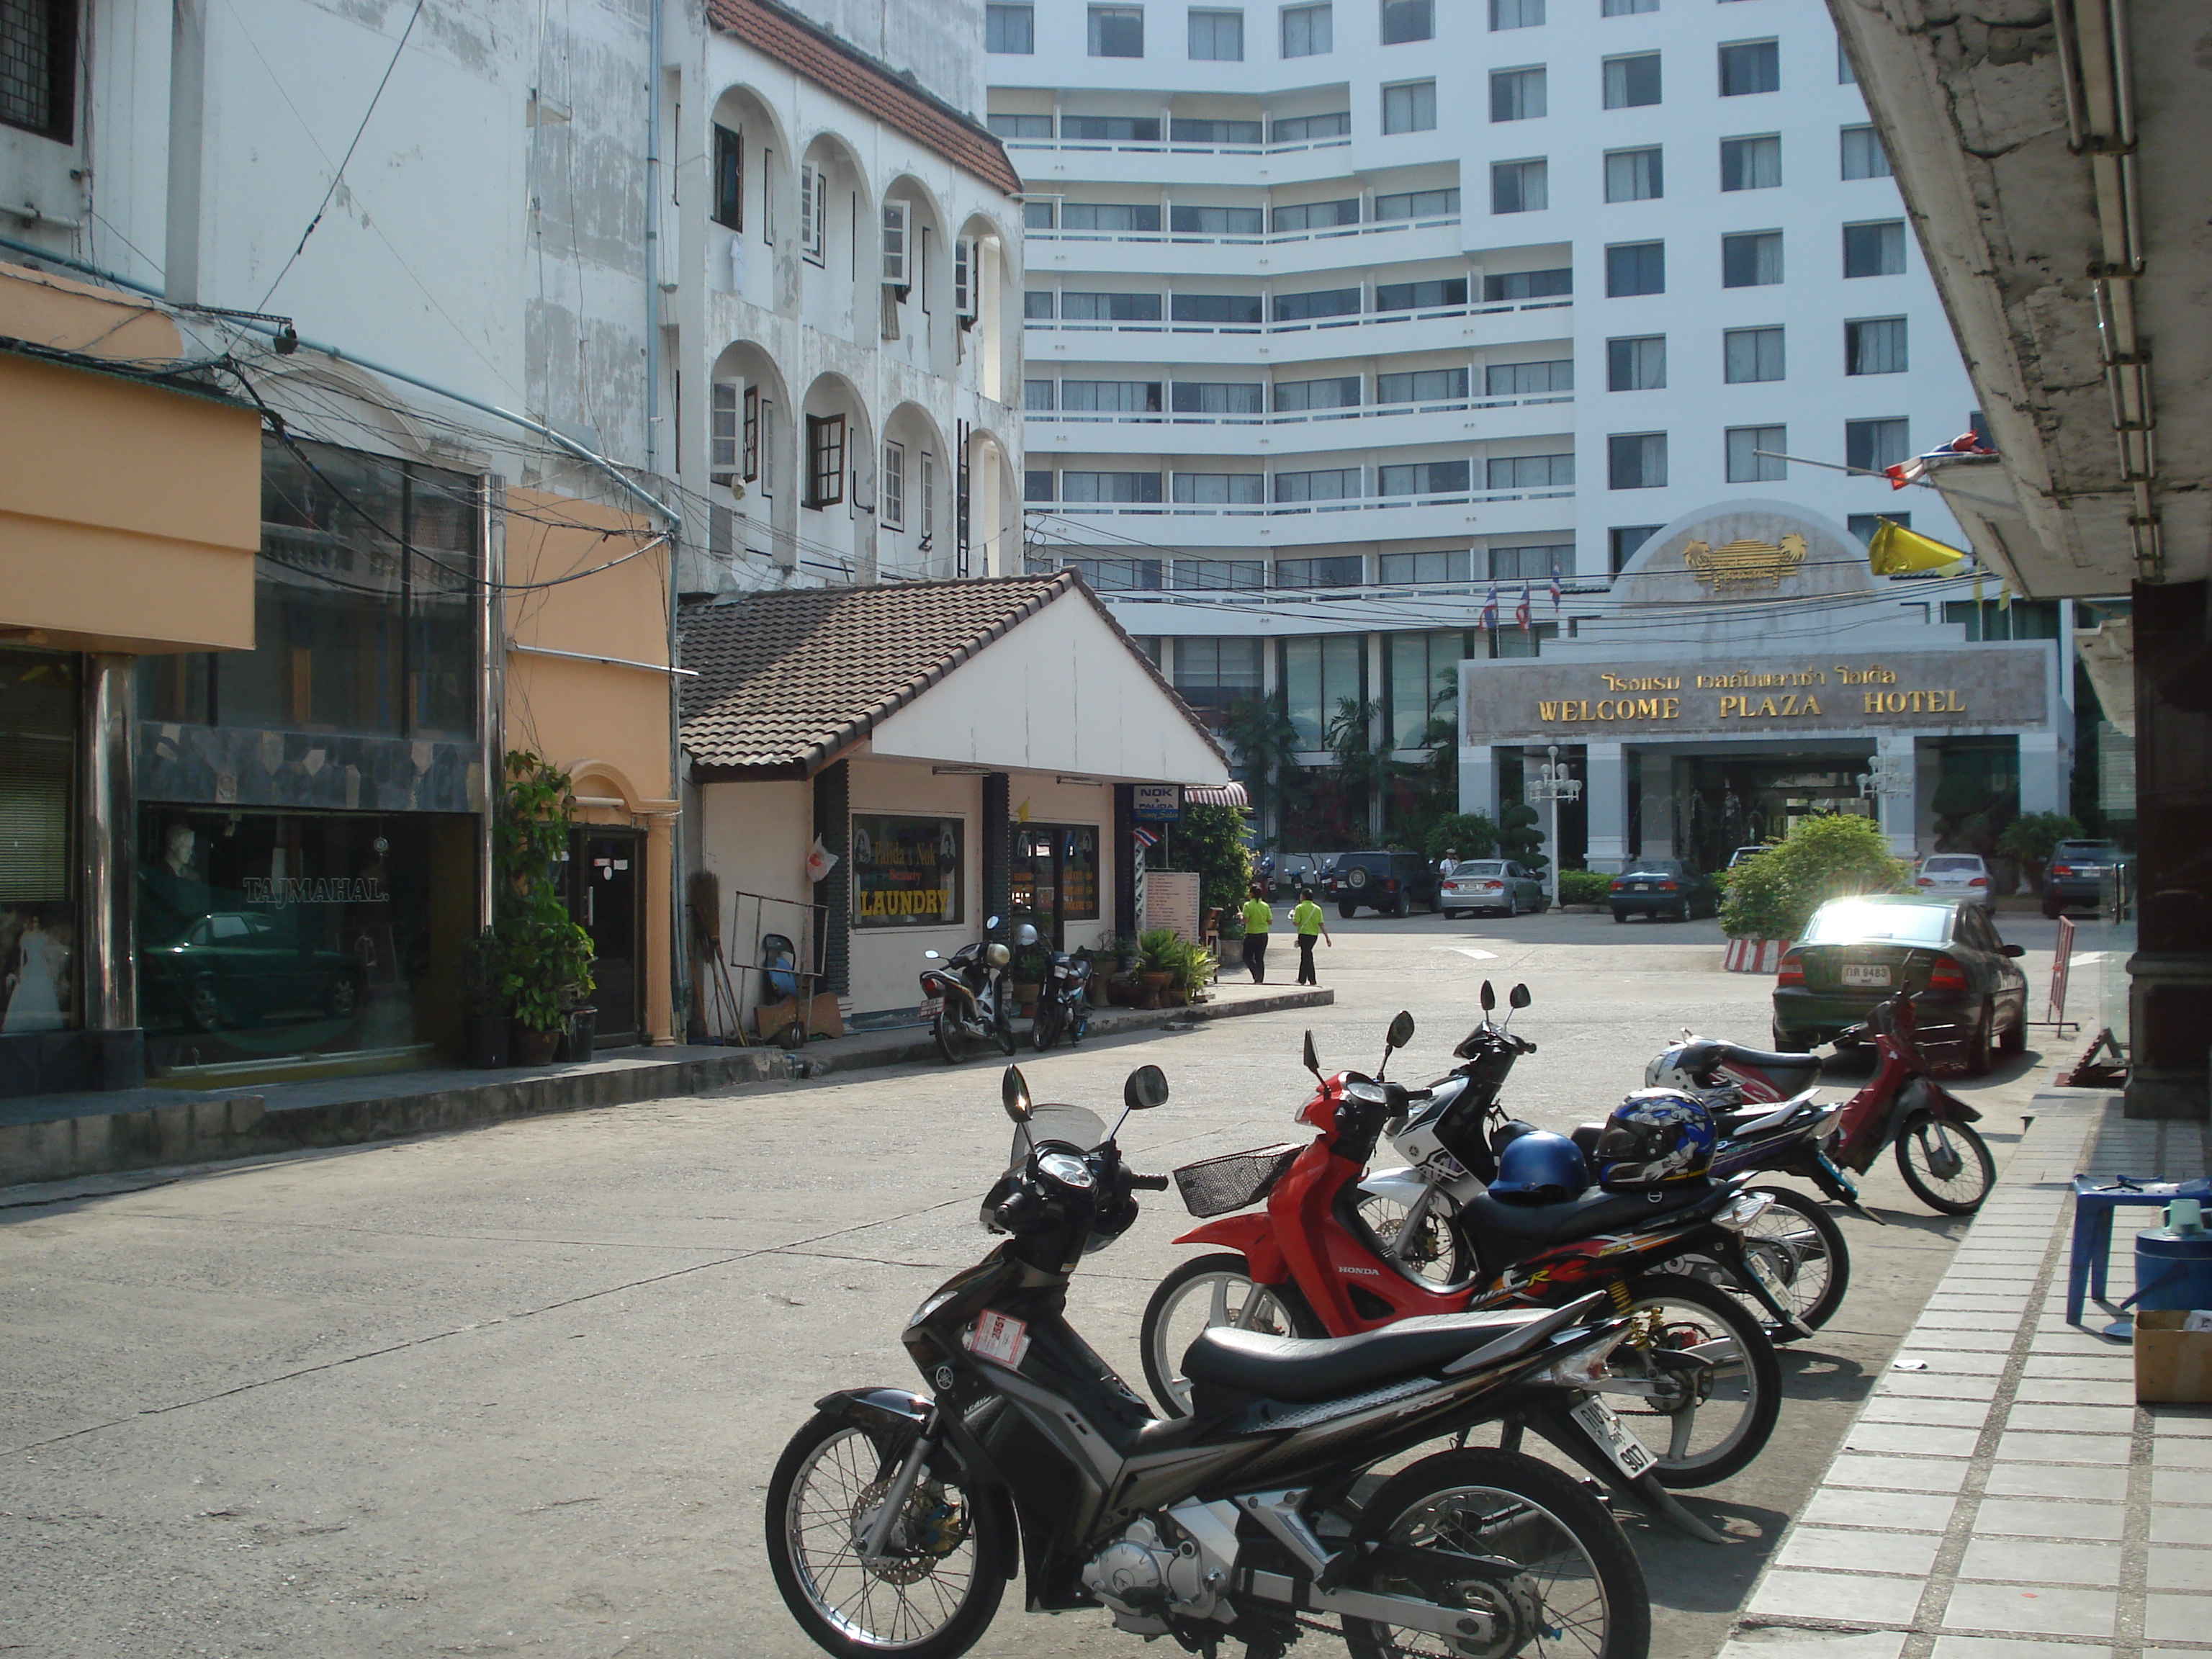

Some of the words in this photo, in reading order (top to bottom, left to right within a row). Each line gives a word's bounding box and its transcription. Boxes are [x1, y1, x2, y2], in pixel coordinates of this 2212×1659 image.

[1601, 673, 1681, 691] โรงแรม
[1538, 697, 1680, 721] WELCOME
[1719, 694, 1822, 718] PLAZA
[1863, 690, 1966, 714] HOTEL
[874, 841, 905, 865] Palida
[917, 842, 935, 866] Nok
[889, 868, 922, 885] Beauty
[860, 889, 949, 916] LAUNDRY
[1339, 1267, 1380, 1276] HONDA
[991, 1316, 1006, 1341] 2551
[1620, 1444, 1650, 1473] 907
